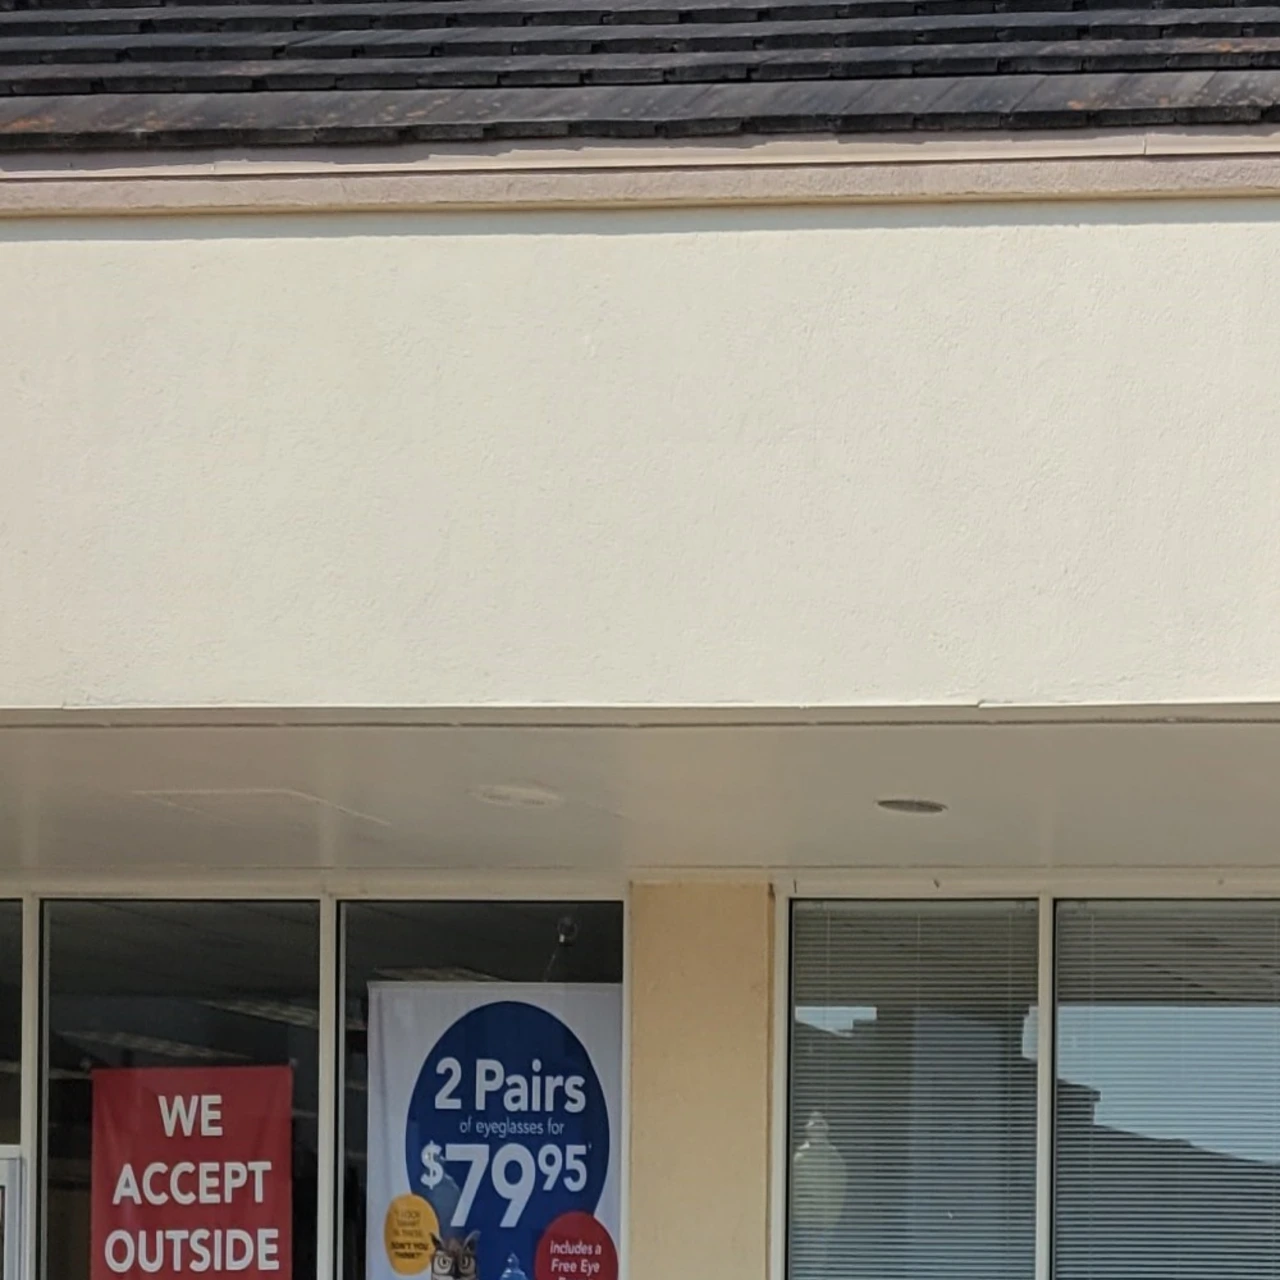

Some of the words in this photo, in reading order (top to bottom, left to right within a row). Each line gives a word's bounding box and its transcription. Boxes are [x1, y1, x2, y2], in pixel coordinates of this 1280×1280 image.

[434, 1056, 463, 1111] 2
[475, 1058, 587, 1113] Pairs
[157, 1094, 224, 1138] WE
[459, 1116, 473, 1134] of
[475, 1117, 543, 1138] eyeglasses
[547, 1117, 566, 1135] for
[112, 1160, 272, 1205] ACCEPT
[104, 1228, 280, 1273] OUTSIDE
[550, 1240, 593, 1255] Includes
[595, 1243, 603, 1255] a
[551, 1258, 578, 1273] Free
[580, 1258, 601, 1277] Eye
